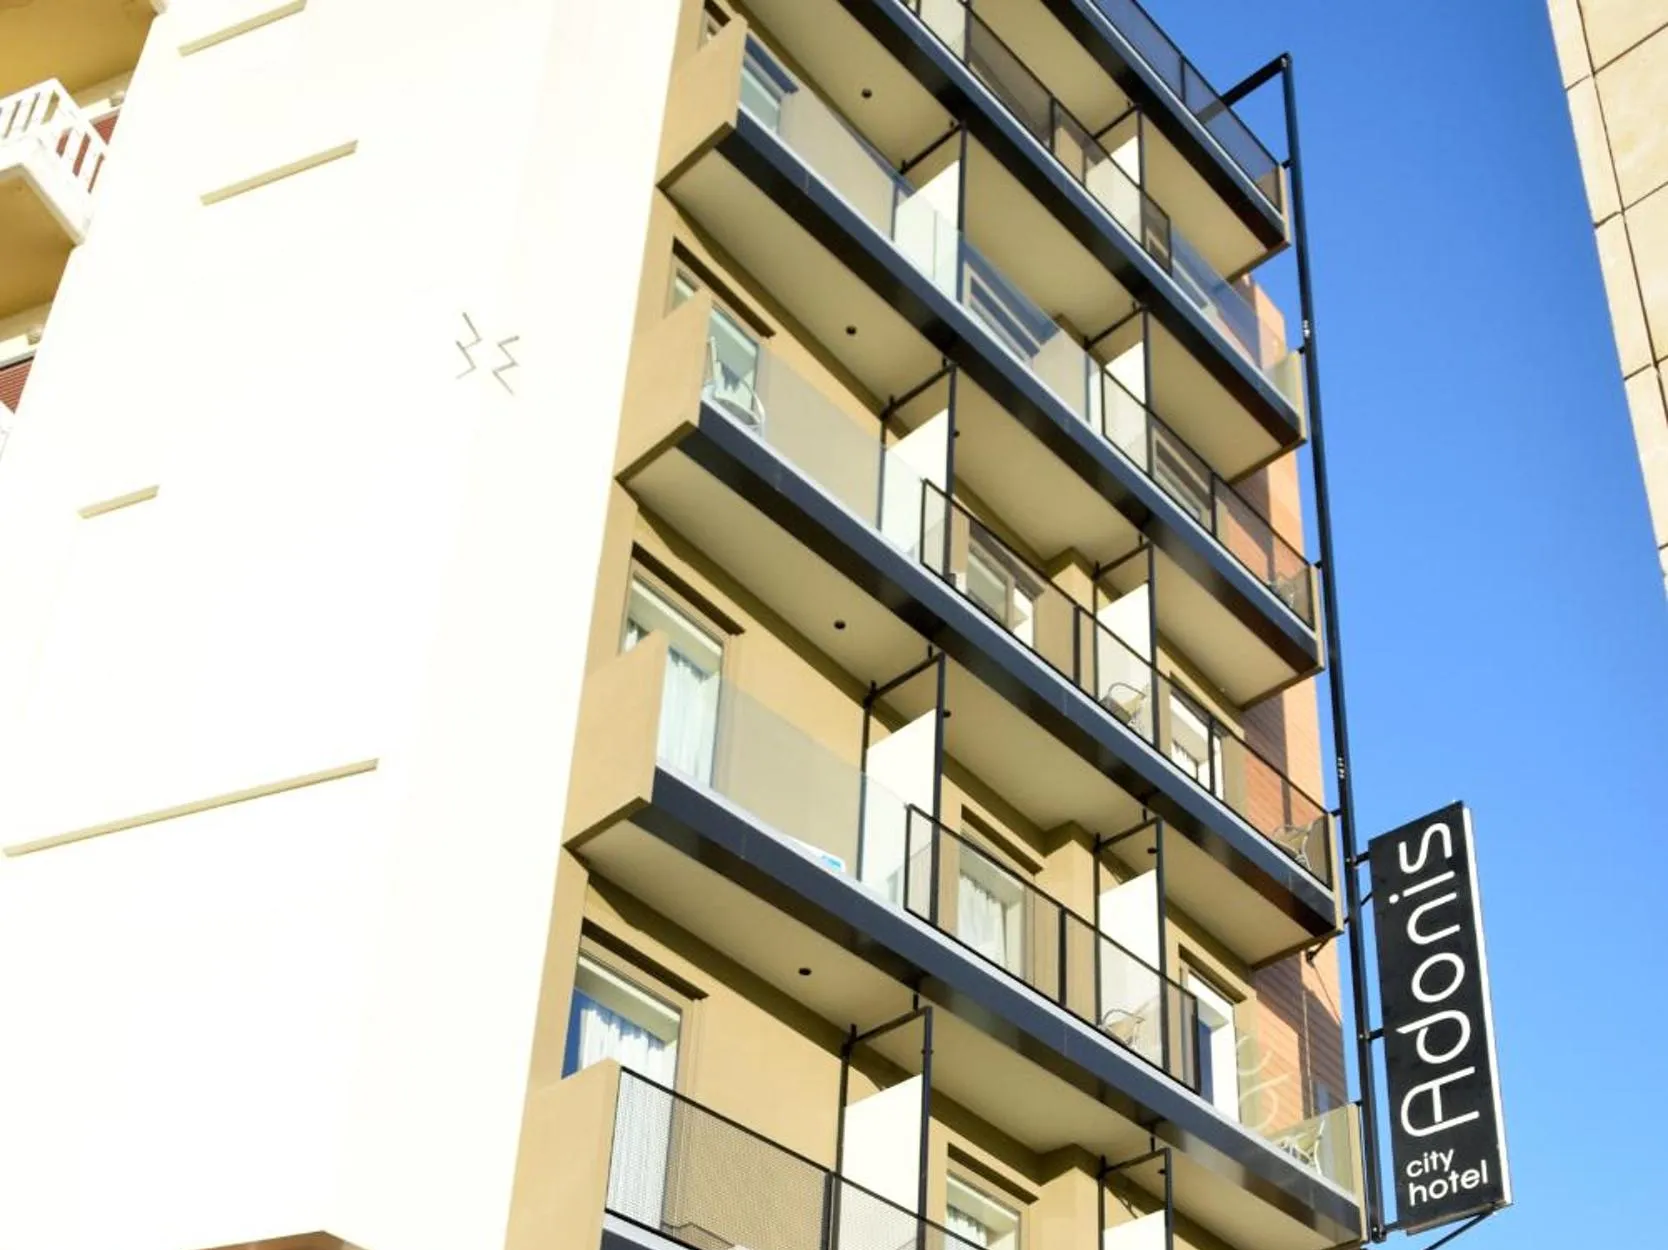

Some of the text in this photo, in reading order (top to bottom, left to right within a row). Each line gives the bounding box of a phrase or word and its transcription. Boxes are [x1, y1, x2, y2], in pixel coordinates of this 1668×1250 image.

[1388, 821, 1480, 1138] Adonis
[1406, 1148, 1455, 1178] city
[1408, 1159, 1489, 1207] hotel
